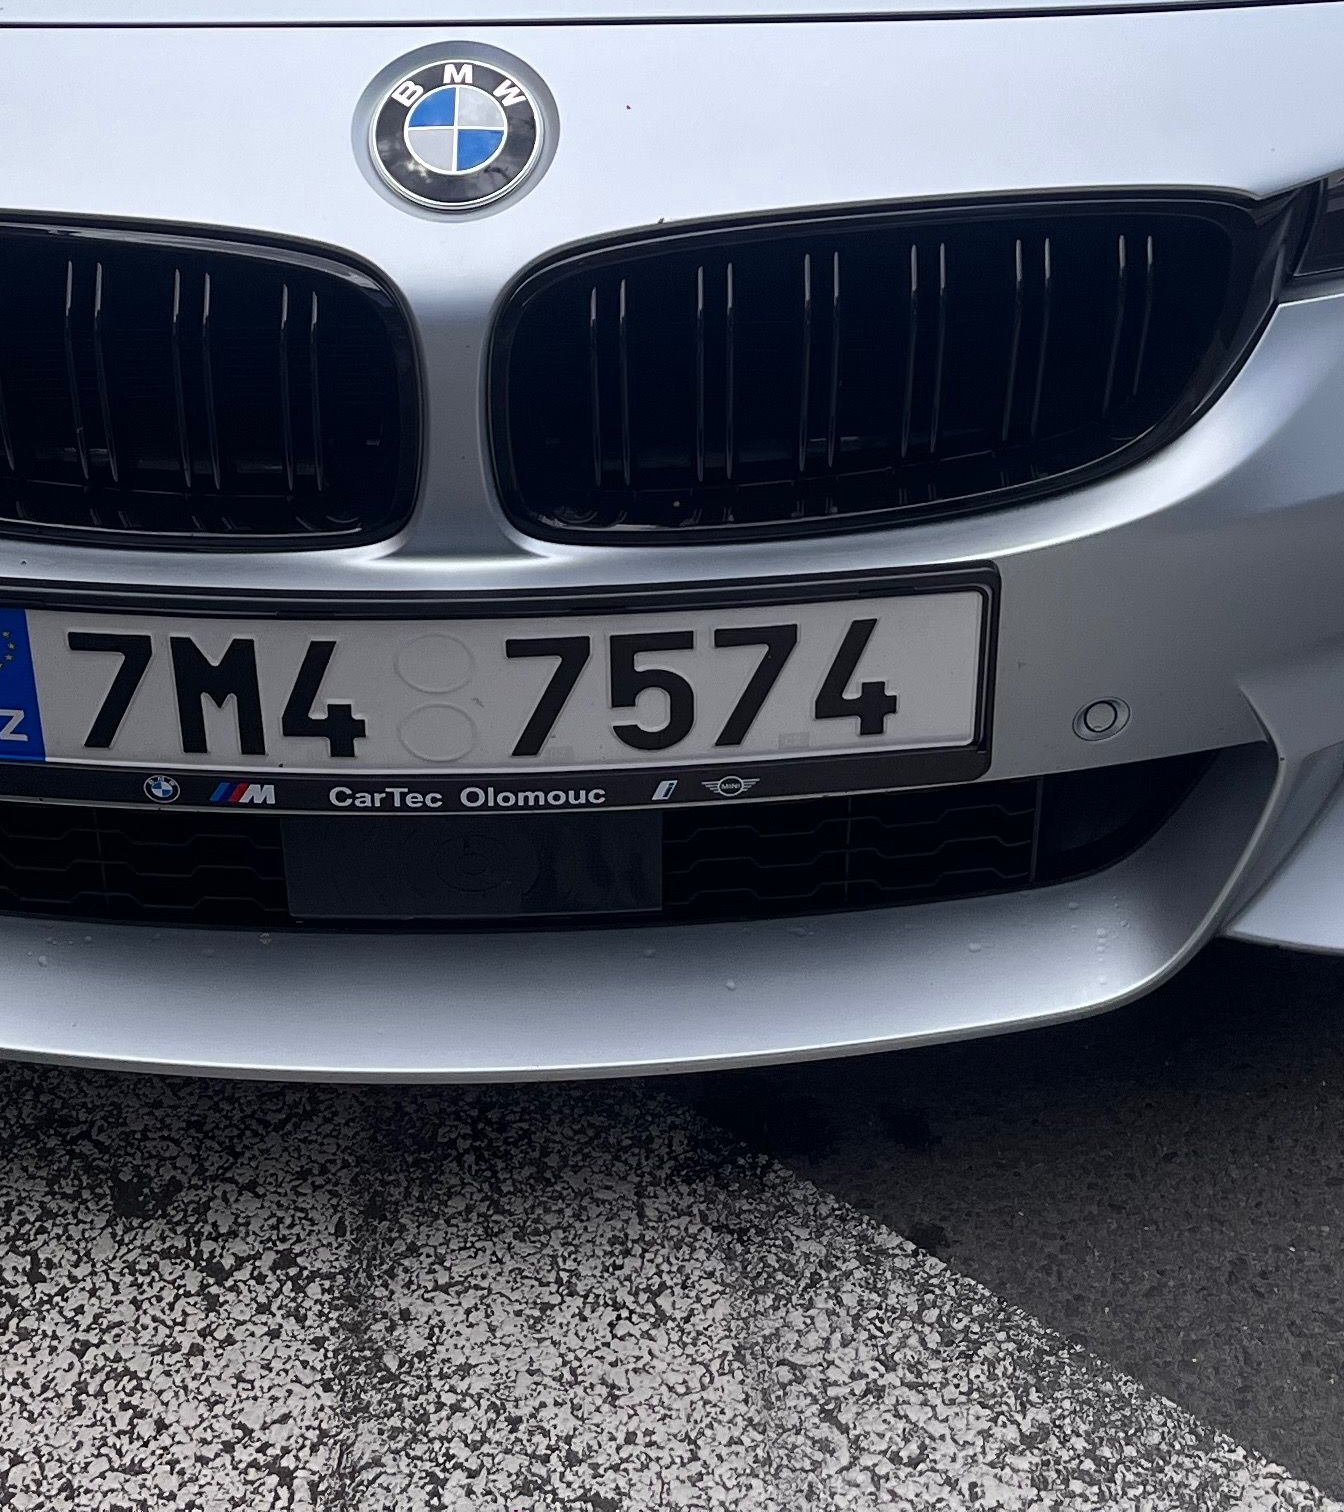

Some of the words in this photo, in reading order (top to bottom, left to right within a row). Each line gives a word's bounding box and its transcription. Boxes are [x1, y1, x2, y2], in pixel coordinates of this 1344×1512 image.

[391, 63, 527, 107] BMW
[67, 631, 367, 758] 7M4
[504, 618, 898, 757] 7574
[329, 787, 443, 809] CarTec
[460, 787, 607, 808] Olomouc
